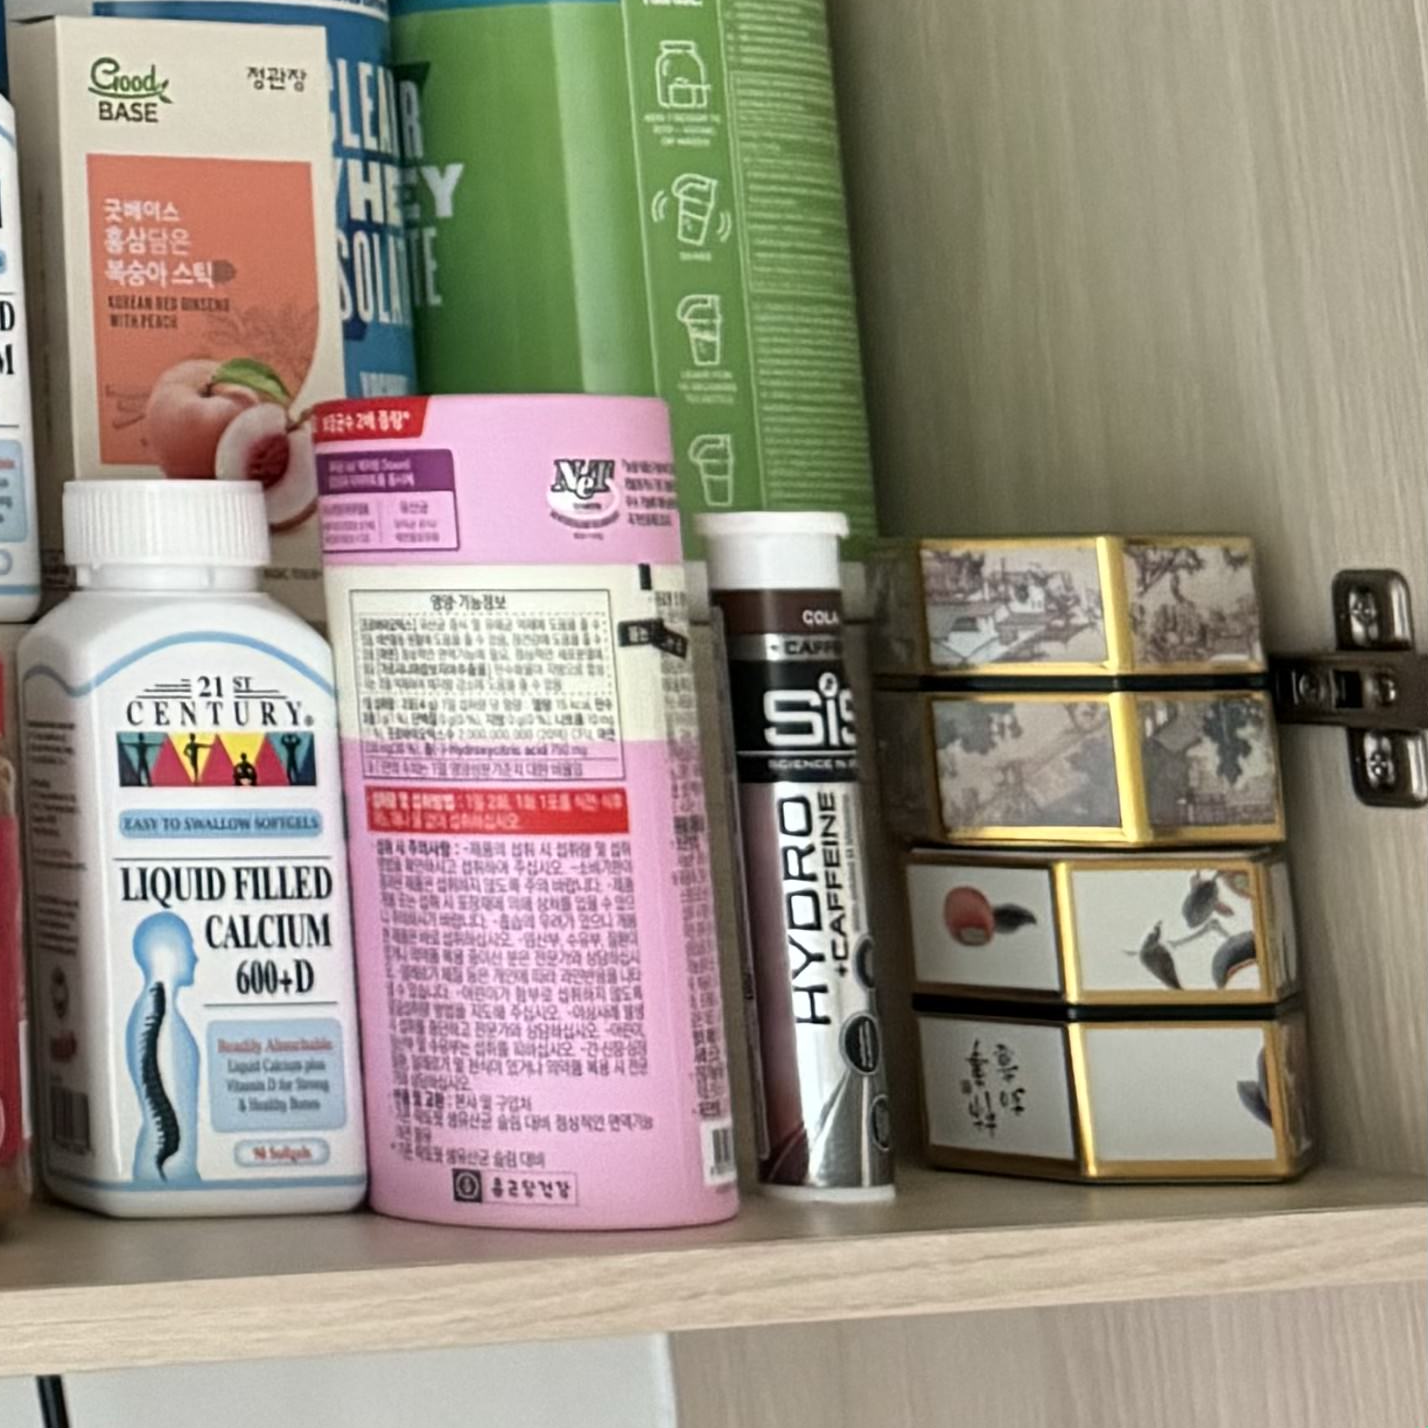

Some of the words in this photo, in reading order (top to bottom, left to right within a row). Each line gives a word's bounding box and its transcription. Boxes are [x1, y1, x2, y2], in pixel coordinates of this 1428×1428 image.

[90, 58, 157, 91] Good
[246, 66, 307, 92] 정관장
[99, 101, 159, 123] BASE
[104, 198, 181, 222] 굿베이스
[104, 259, 168, 287] 복숭아
[171, 261, 214, 289] 스틱
[108, 295, 152, 311] KOREAN
[156, 296, 177, 311] RED
[197, 676, 223, 698] 21
[232, 677, 252, 692] ST
[126, 700, 302, 726] CENTURY
[124, 818, 157, 831] EASY
[163, 818, 180, 831] TO
[183, 817, 250, 831] SWALLOW
[254, 816, 318, 830] SOFTGELS
[119, 866, 226, 908] LIQUID
[232, 866, 333, 901] FILLED
[816, 791, 849, 978] +CAFFEINE
[778, 795, 832, 1026] HYDRO
[205, 913, 332, 949] CALCIUM
[236, 959, 314, 994] 600+D
